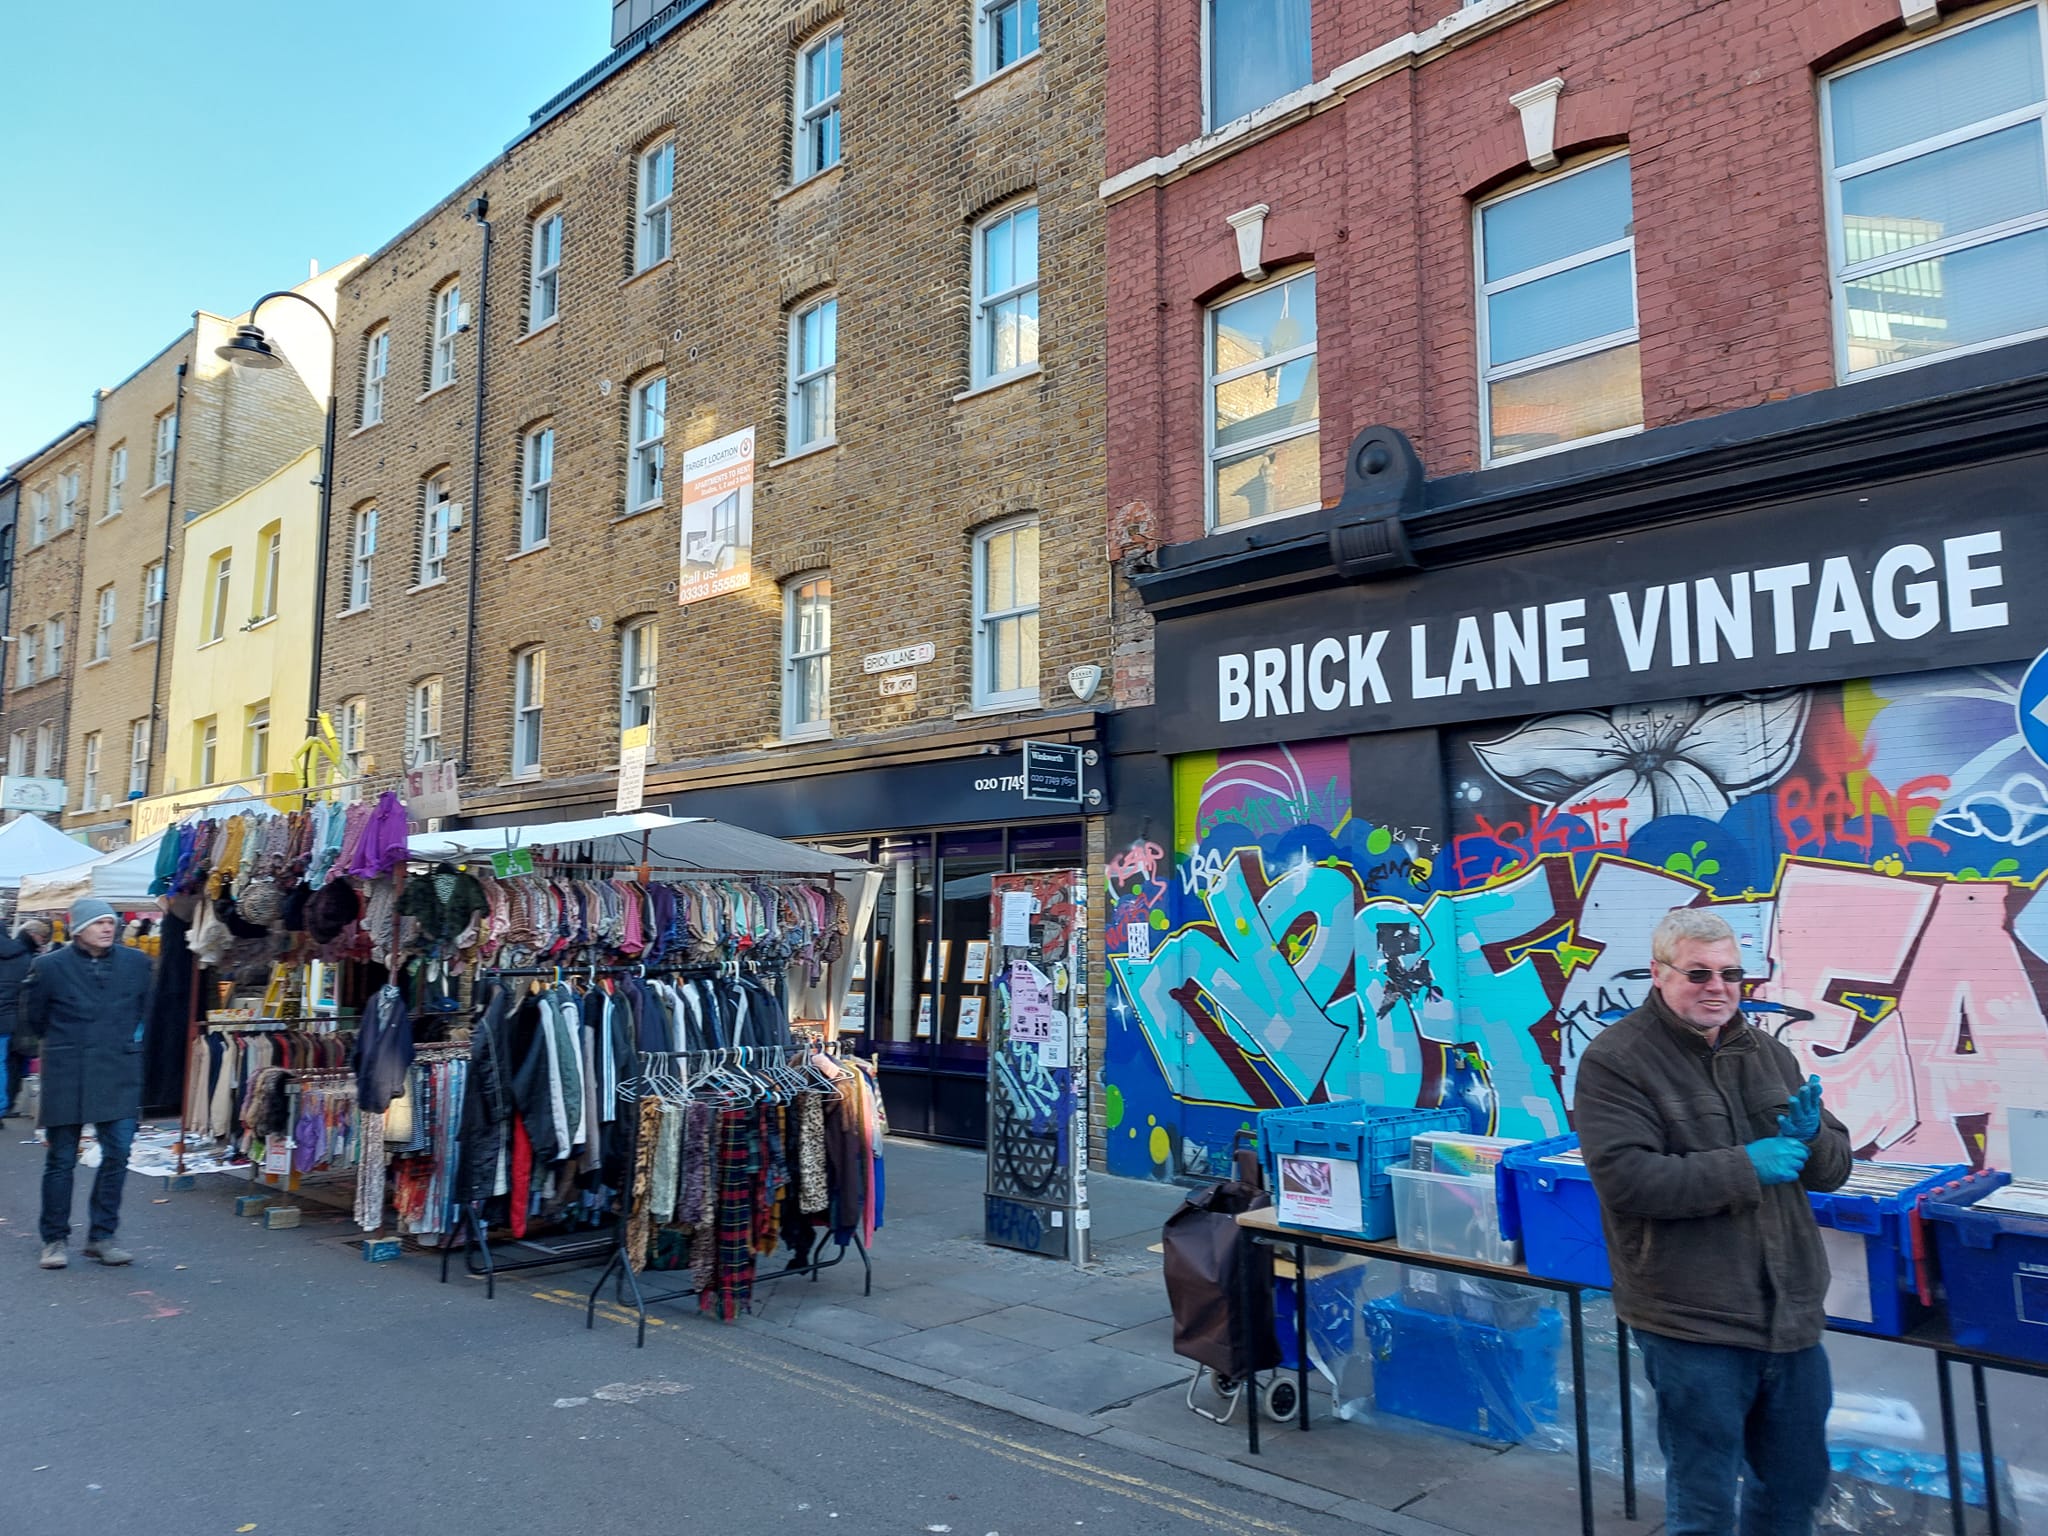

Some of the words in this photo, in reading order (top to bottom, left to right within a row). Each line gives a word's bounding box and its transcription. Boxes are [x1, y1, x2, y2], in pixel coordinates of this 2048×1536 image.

[685, 457, 708, 472] TARGET
[708, 445, 739, 464] LOCATION
[682, 570, 700, 586] Call
[703, 568, 718, 580] us:
[1218, 629, 1392, 722] BRICK
[1410, 598, 1590, 700] LANE
[1609, 531, 2009, 672] VINTAGE
[866, 654, 890, 670] BRICK
[893, 649, 916, 664] LANE
[974, 777, 998, 791] 020
[1031, 774, 1044, 782] 020
